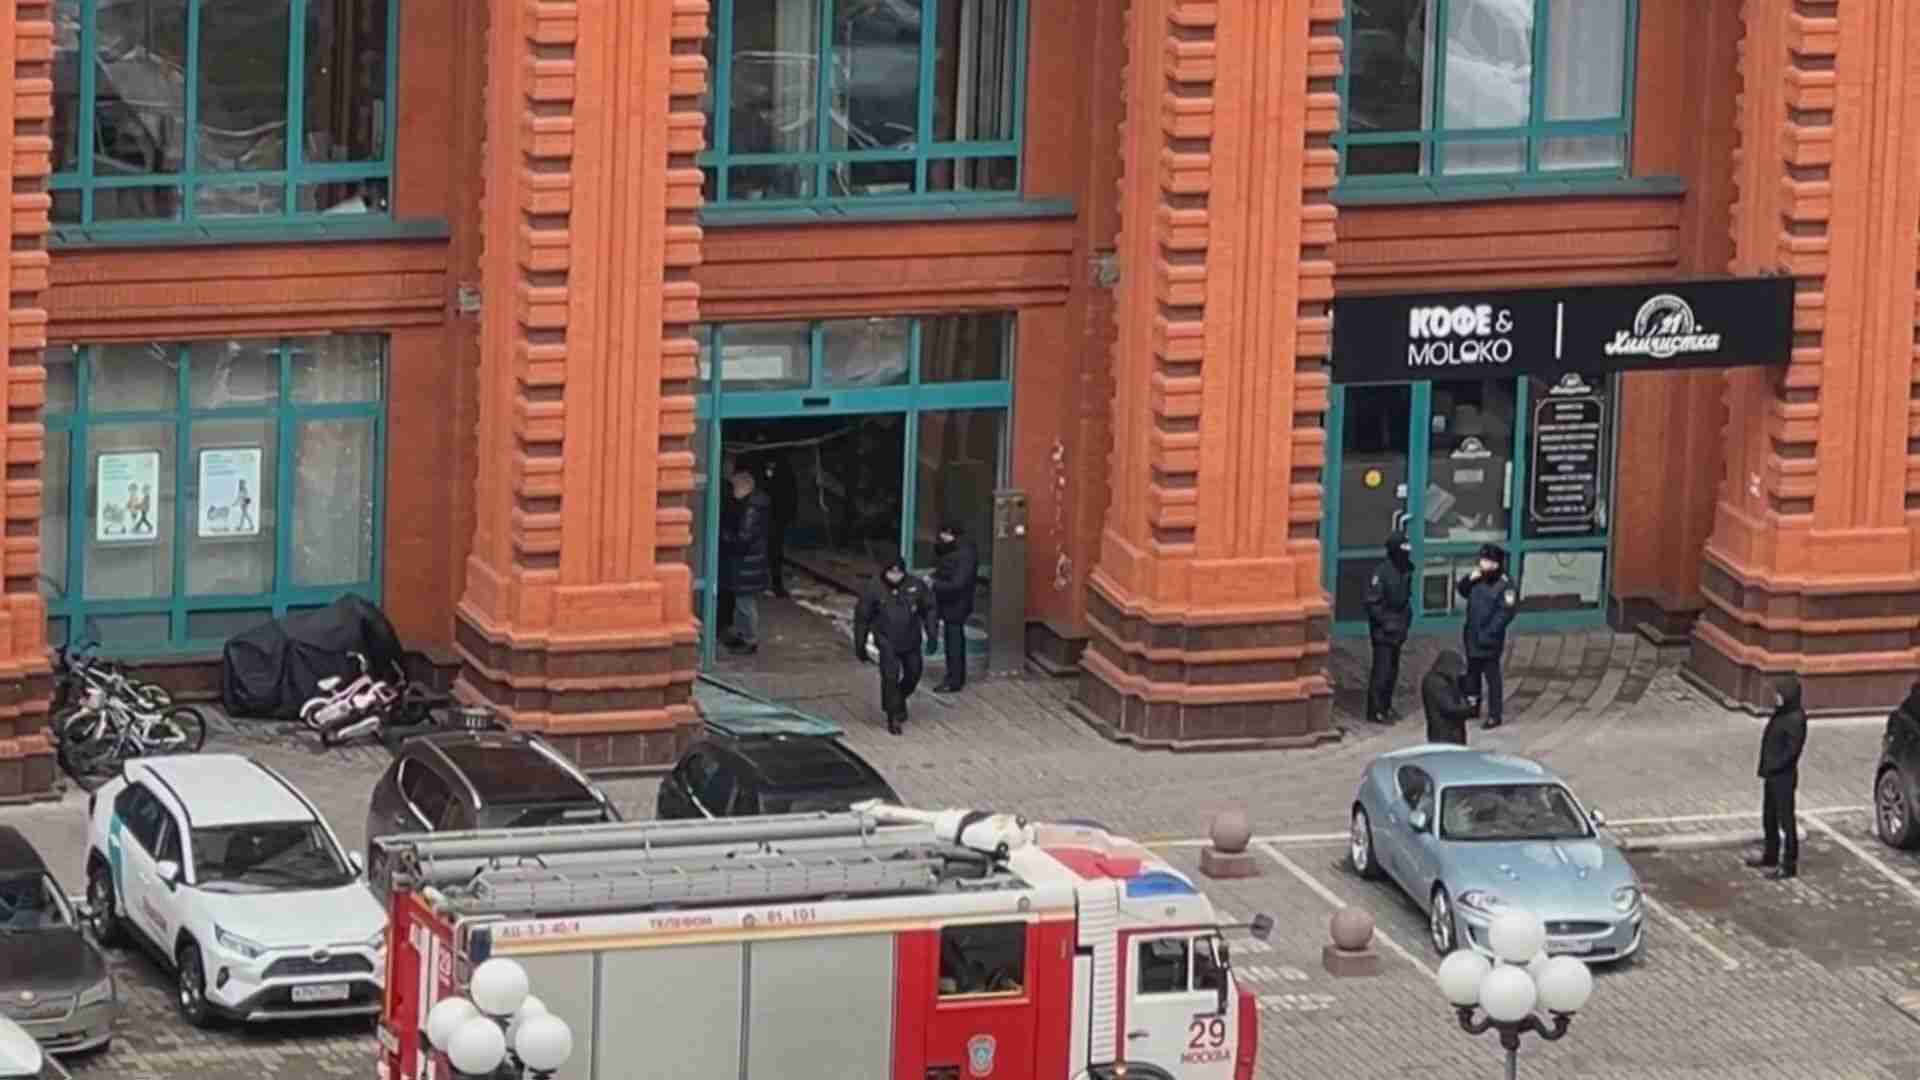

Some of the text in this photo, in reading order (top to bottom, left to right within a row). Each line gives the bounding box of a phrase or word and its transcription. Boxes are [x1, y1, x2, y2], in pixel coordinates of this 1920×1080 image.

[1410, 305, 1513, 338] КОФЕ &
[1189, 1019, 1225, 1048] 29
